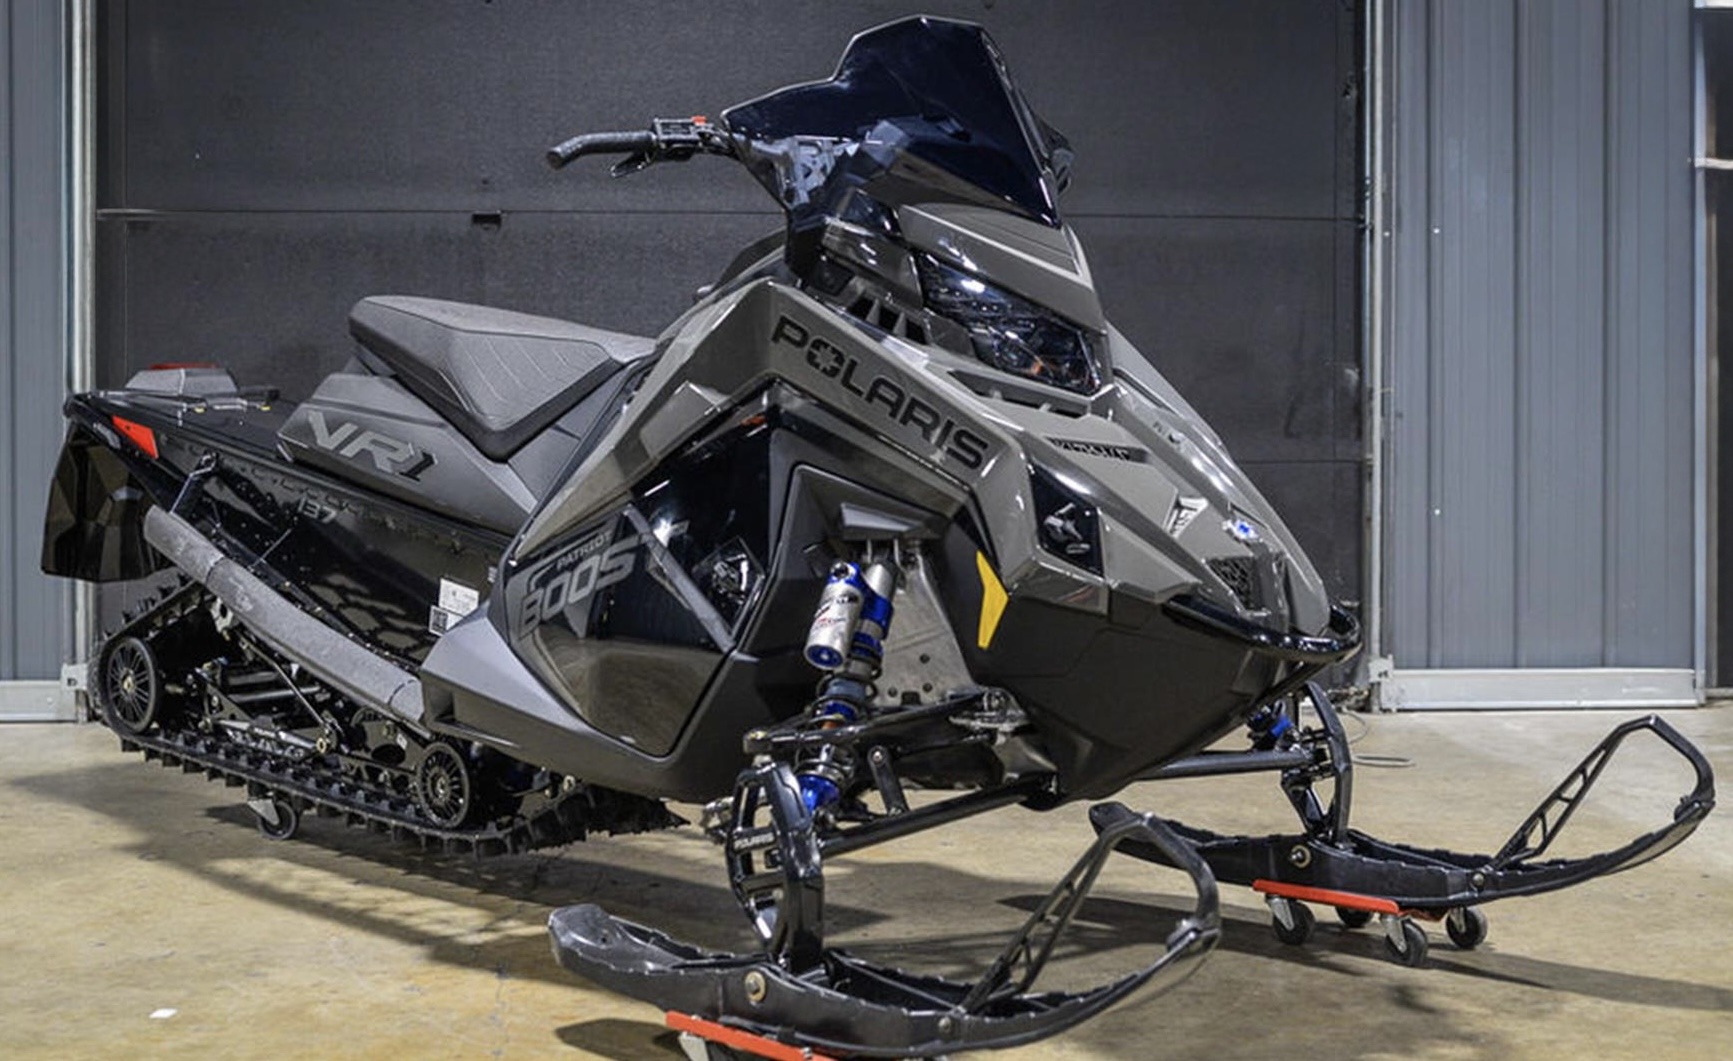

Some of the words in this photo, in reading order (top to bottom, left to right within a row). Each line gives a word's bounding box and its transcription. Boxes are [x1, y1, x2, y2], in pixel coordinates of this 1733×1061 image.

[771, 315, 989, 470] POLARIS
[308, 409, 438, 482] VR1
[298, 496, 337, 524] 137
